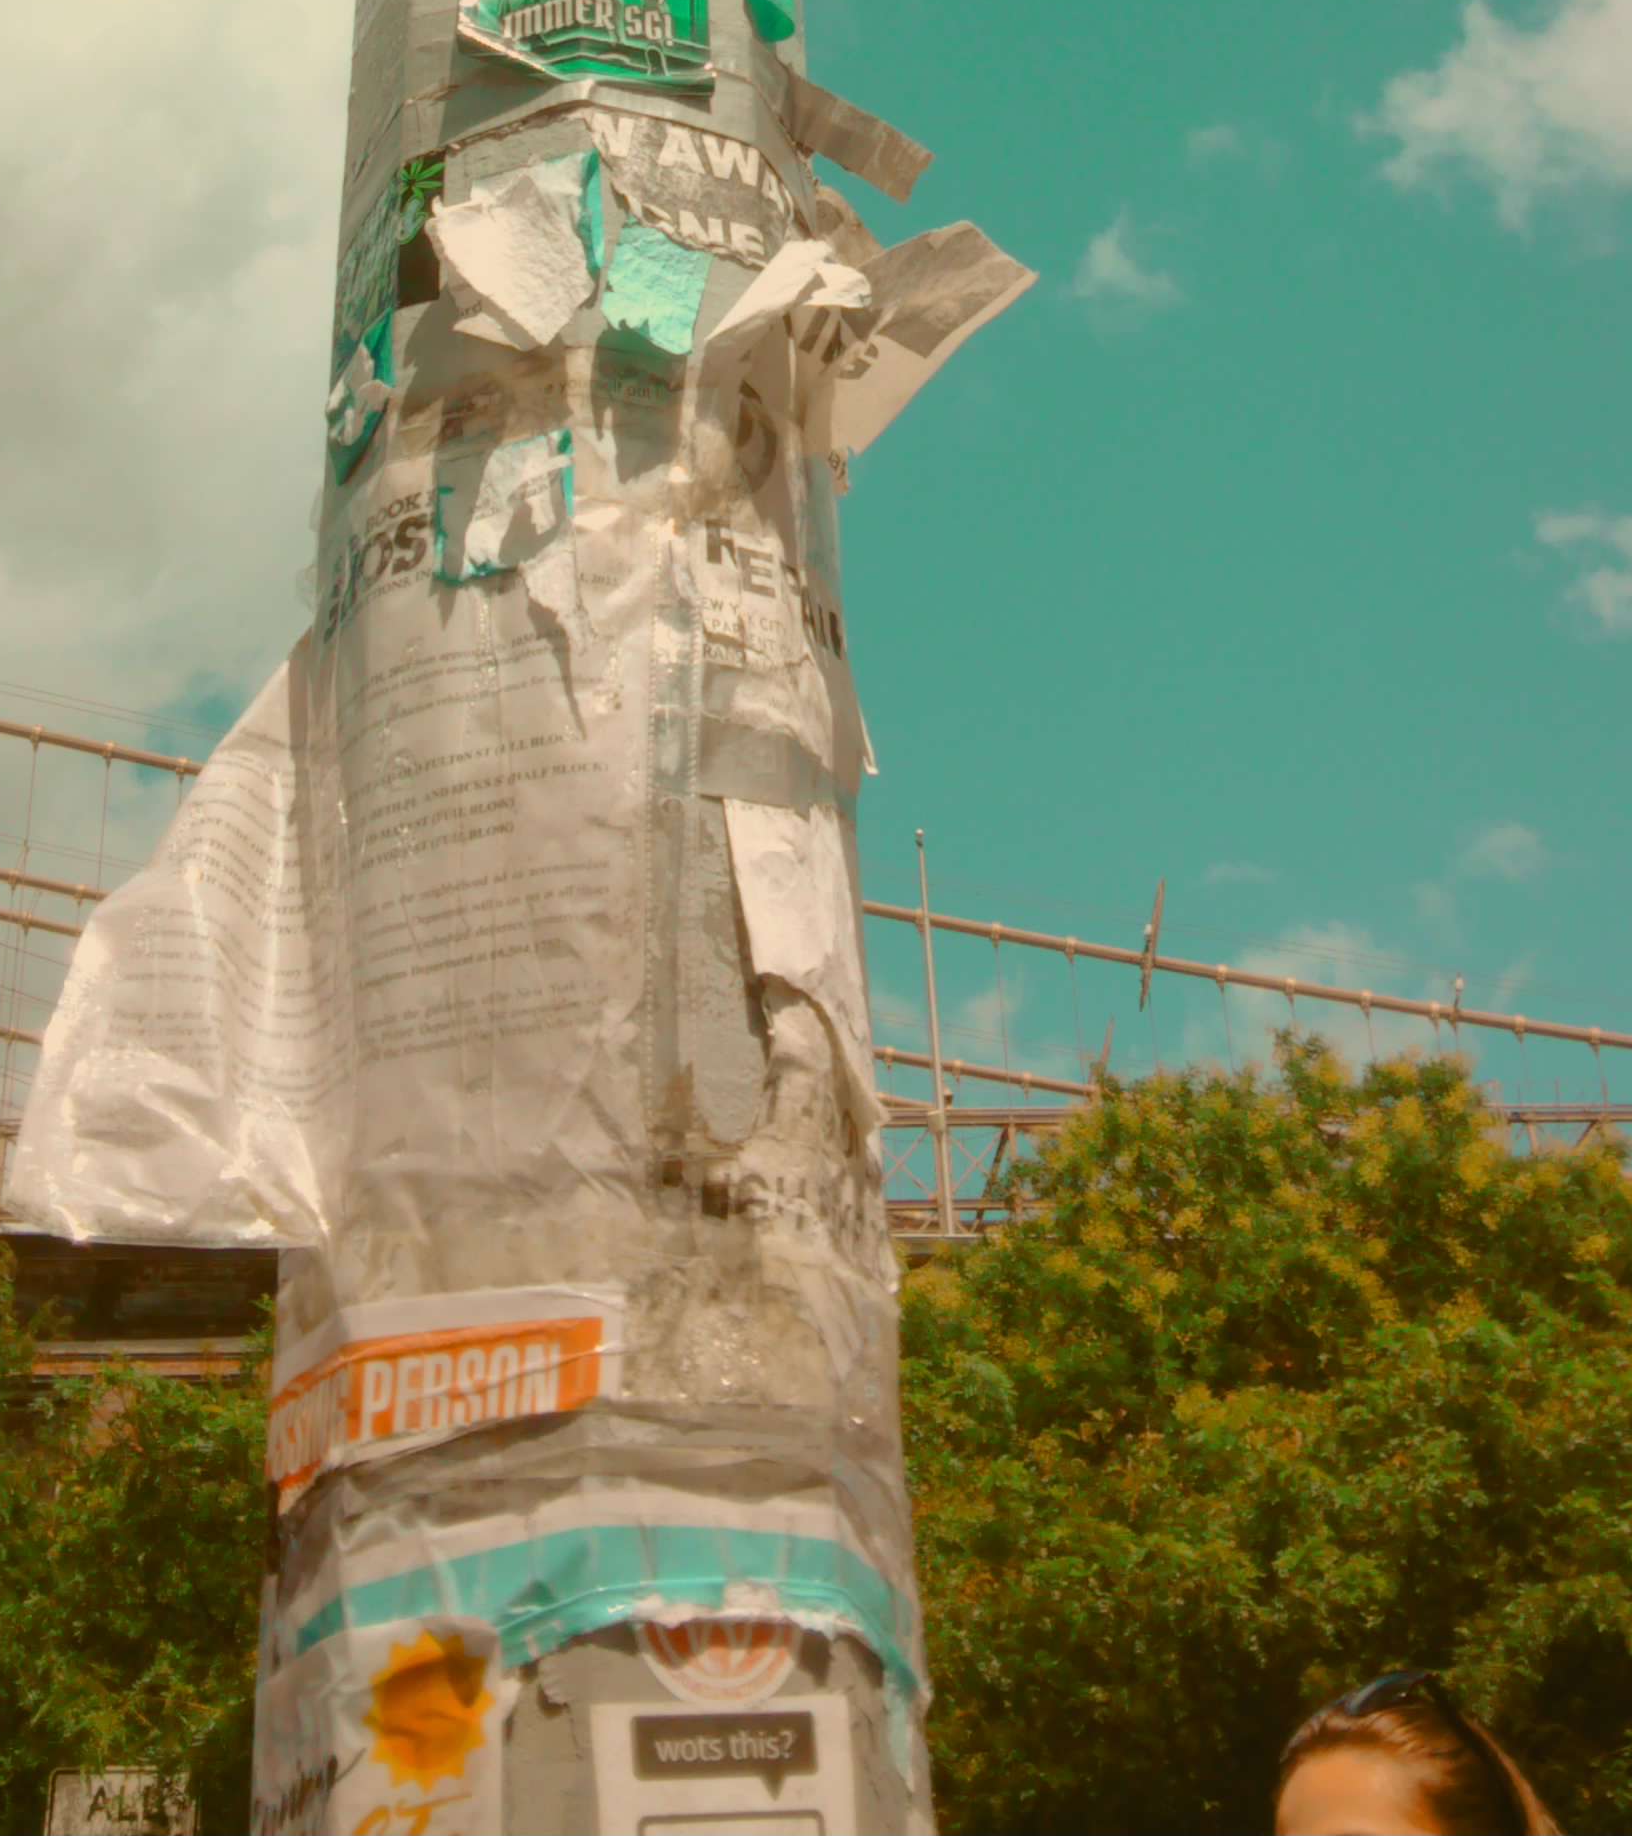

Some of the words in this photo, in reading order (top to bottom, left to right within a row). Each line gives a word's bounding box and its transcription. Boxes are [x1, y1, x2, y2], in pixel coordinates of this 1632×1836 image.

[360, 1341, 561, 1444] PERSON
[654, 1733, 723, 1764] wots
[728, 1729, 799, 1761] this?
